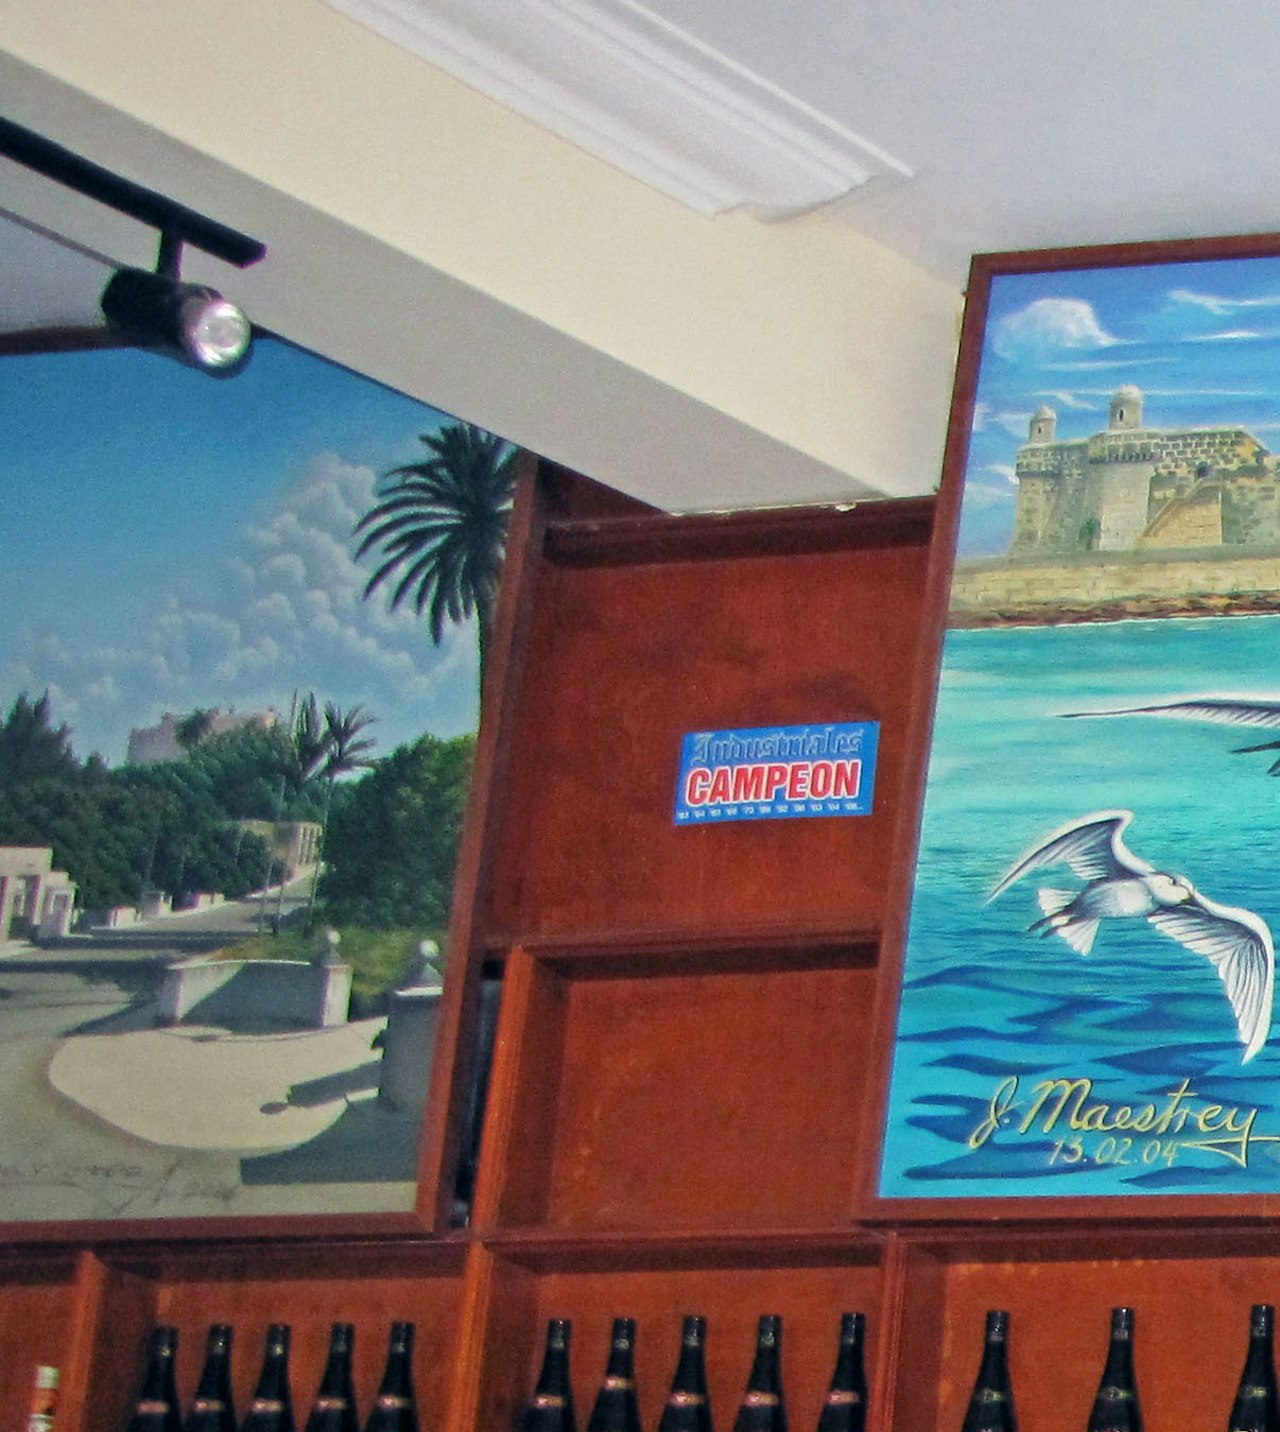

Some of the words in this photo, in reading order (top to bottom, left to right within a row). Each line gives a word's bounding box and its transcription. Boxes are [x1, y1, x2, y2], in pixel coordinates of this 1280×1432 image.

[691, 728, 865, 766] Industriales
[686, 760, 862, 807] CAMPEON
[1019, 1077, 1262, 1167] Maestrey
